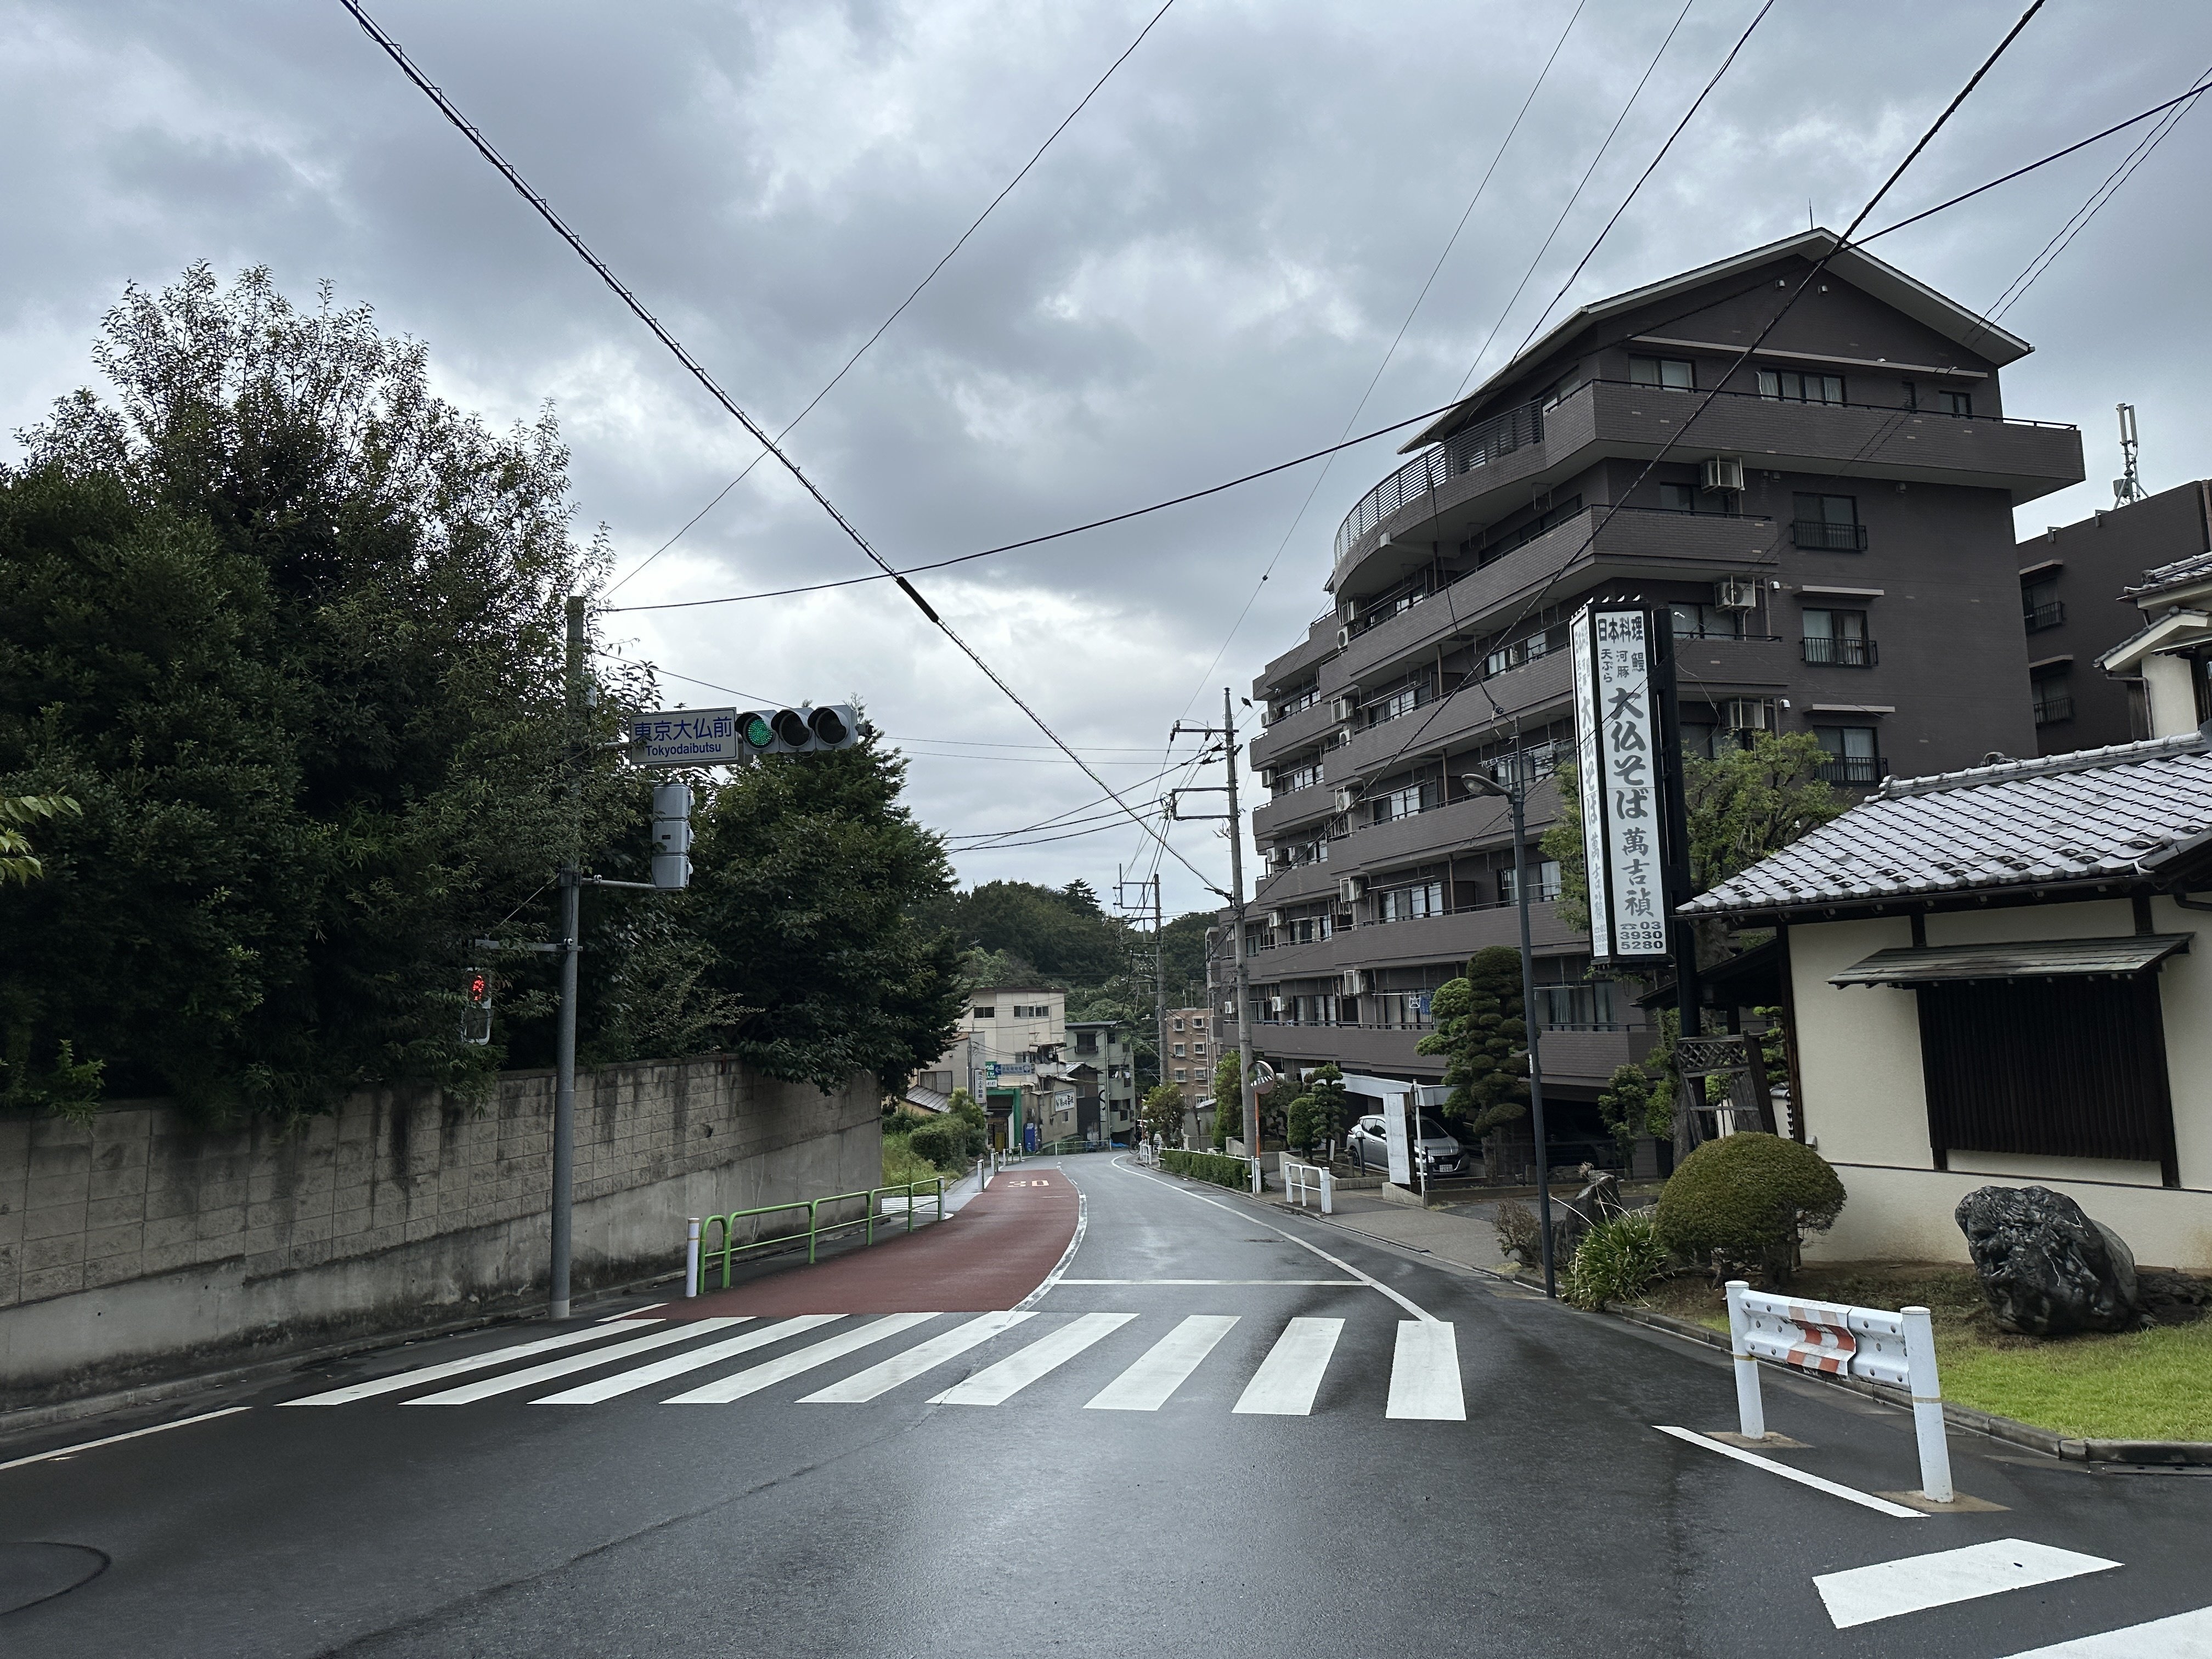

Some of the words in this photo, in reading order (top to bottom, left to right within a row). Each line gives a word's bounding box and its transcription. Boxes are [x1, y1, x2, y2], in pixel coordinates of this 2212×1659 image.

[1598, 616, 1644, 644] 日本料理
[1601, 648, 1613, 683] 天ぷら
[1616, 650, 1629, 679] 河豚
[1631, 652, 1645, 673] 鰻
[634, 716, 732, 743] 東京大仏前
[645, 742, 721, 757] Tokyodaibutsu
[1607, 687, 1649, 820] 大仏そば
[1620, 931, 1663, 940] 3930
[1640, 921, 1661, 930] 03
[1621, 941, 1663, 950] 5280
[1007, 1180, 1049, 1188] 30
